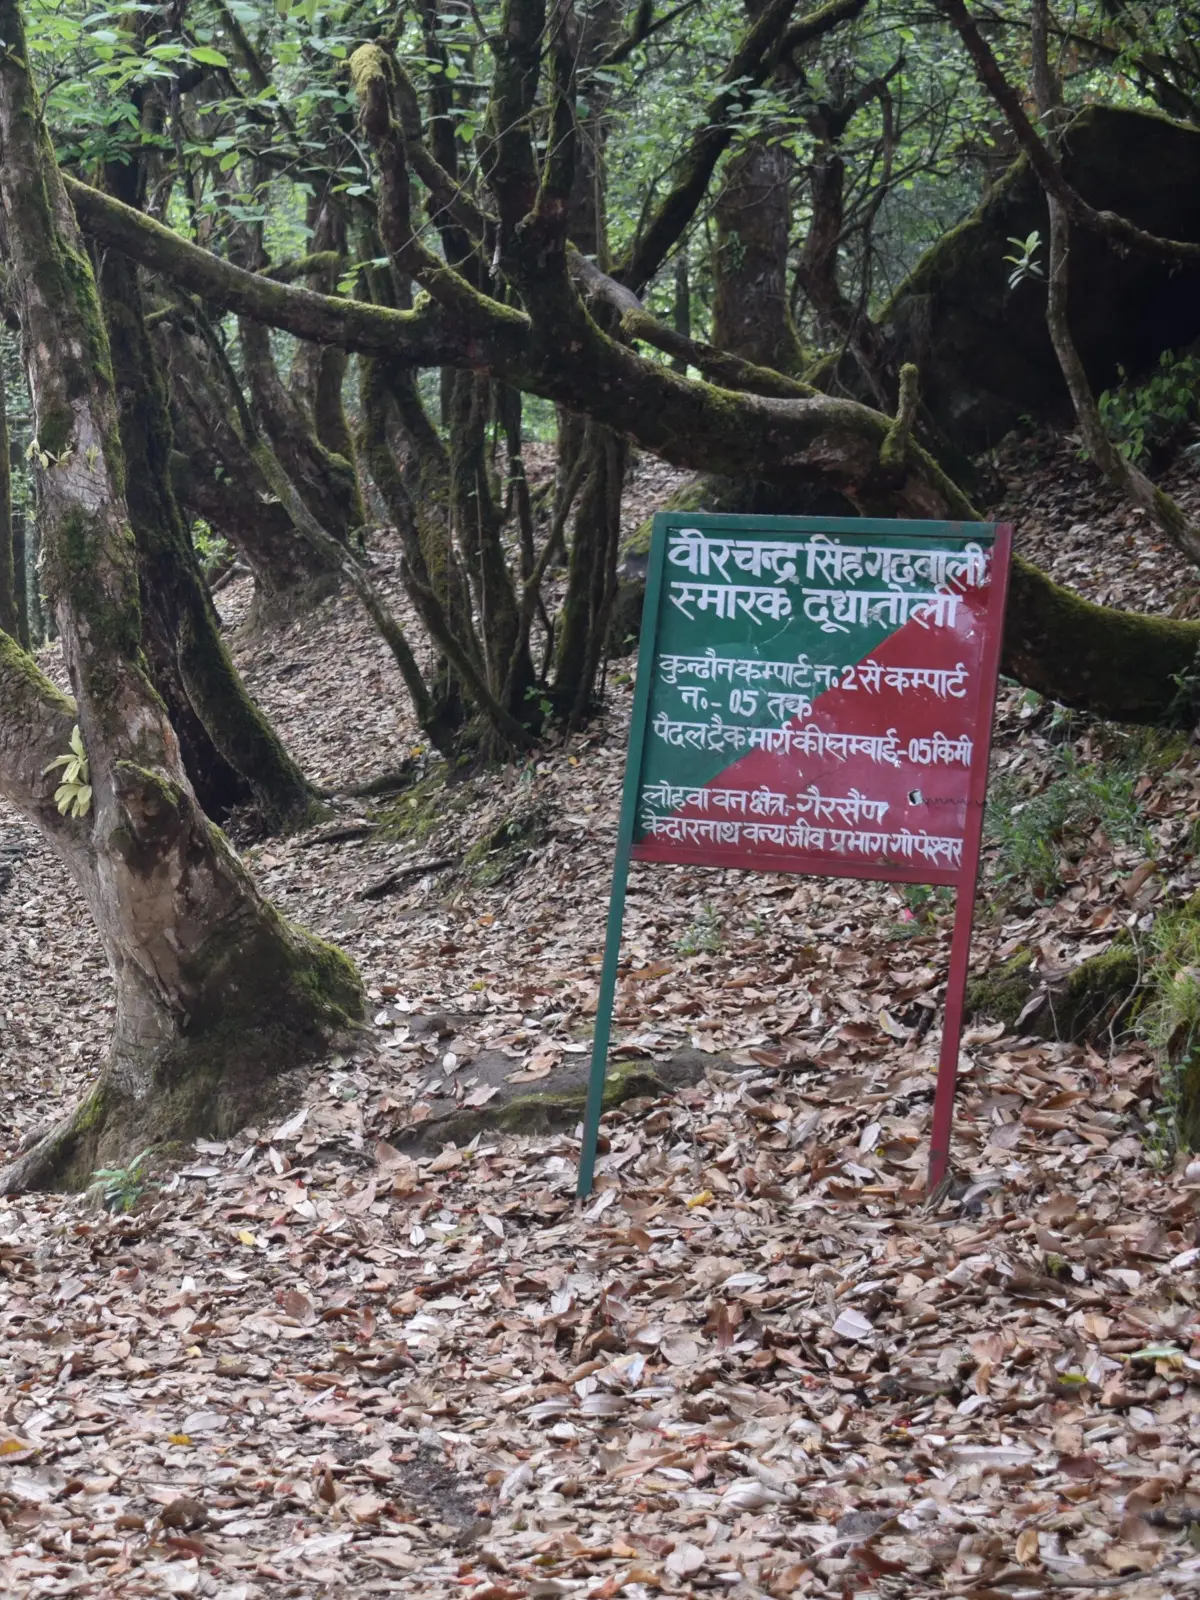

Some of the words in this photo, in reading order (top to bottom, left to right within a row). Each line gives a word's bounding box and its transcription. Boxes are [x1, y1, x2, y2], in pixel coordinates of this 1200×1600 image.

[668, 529, 734, 583] वीर
[804, 534, 866, 585] सिंह
[669, 581, 792, 626] स्मारक
[801, 583, 964, 633] दूधातोली
[735, 654, 814, 688] कम्पार्ट
[857, 660, 886, 694] से
[884, 662, 969, 699] कम्पार्ट
[729, 688, 759, 717] 05
[767, 692, 813, 722] तक
[653, 711, 710, 750] पैदल
[707, 713, 746, 753] ट्रैक
[747, 721, 796, 756] मार्ग
[793, 723, 825, 757] की
[712, 788, 749, 814] वन
[796, 785, 890, 825] गैरसैंण
[641, 809, 742, 845] केदारनाथ
[829, 829, 891, 856] प्रभाग
